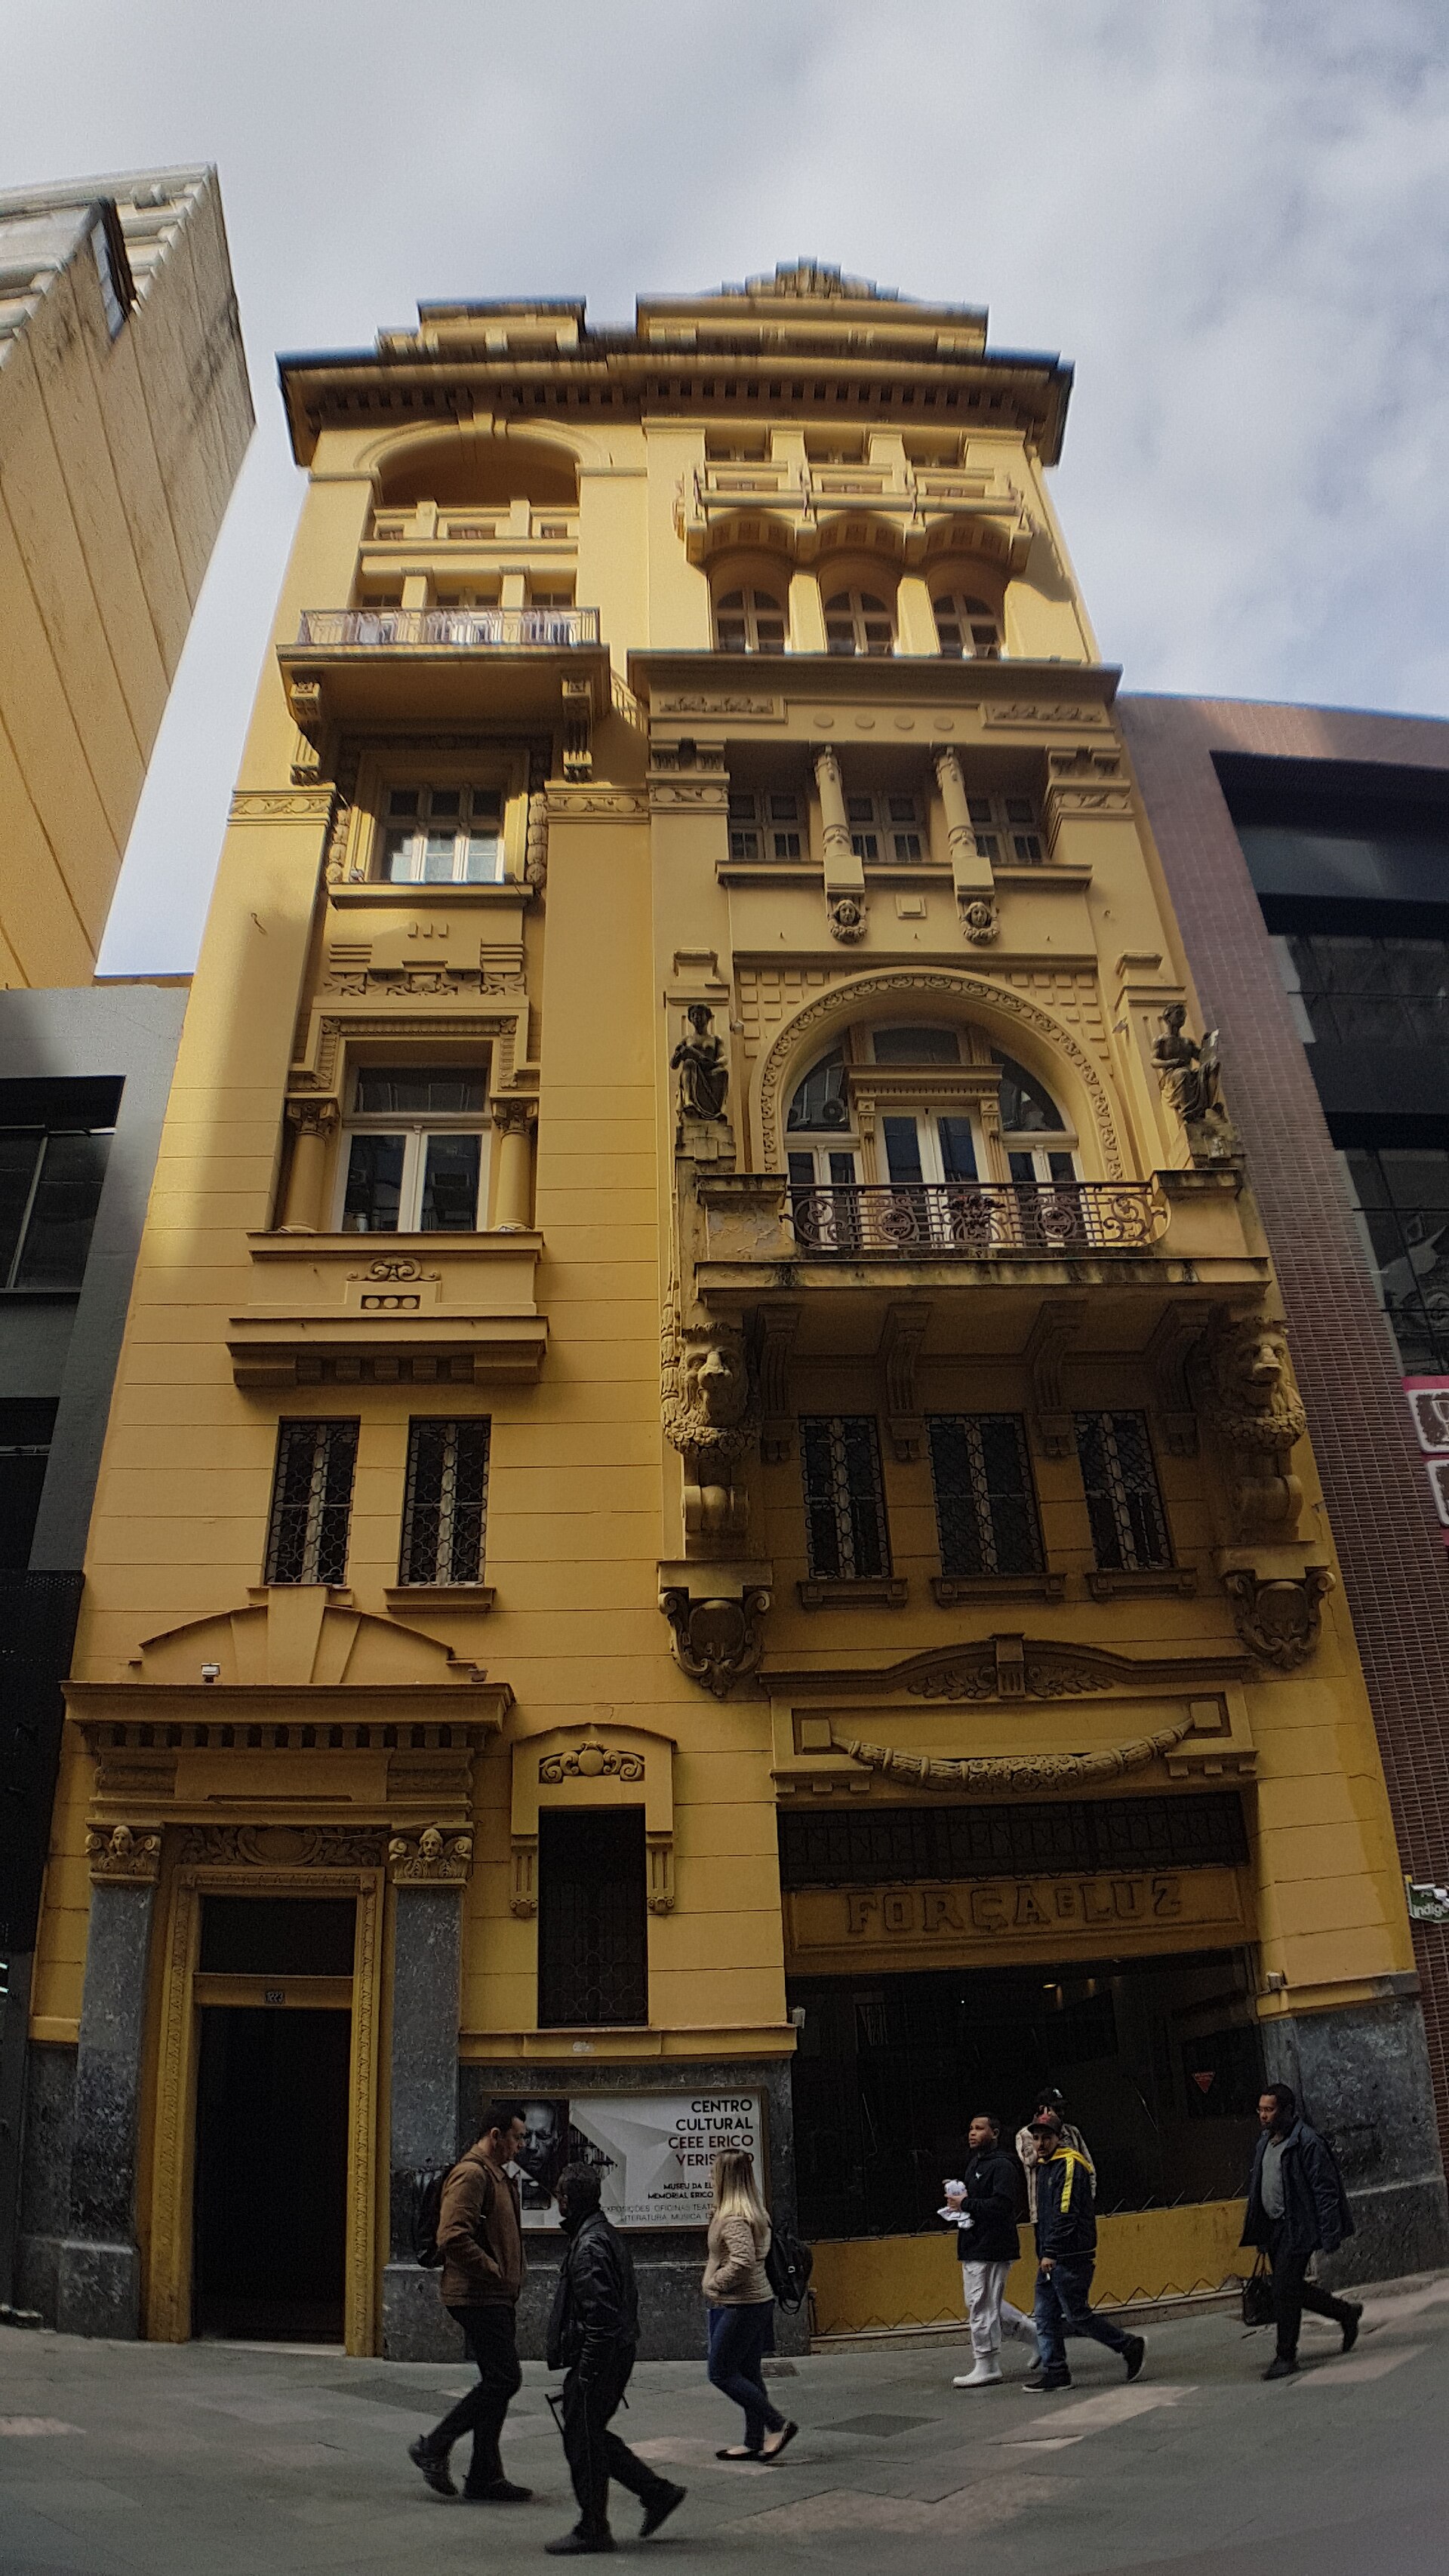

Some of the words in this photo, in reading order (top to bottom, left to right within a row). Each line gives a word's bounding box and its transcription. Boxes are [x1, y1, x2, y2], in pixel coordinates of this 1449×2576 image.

[847, 1885, 1051, 1934] FORÇA
[1081, 1877, 1182, 1924] LUZ
[691, 2098, 752, 2113] CENTRO
[675, 2116, 753, 2131] CULTURAL
[668, 2136, 704, 2150] CEEE
[709, 2134, 754, 2148] ERICO
